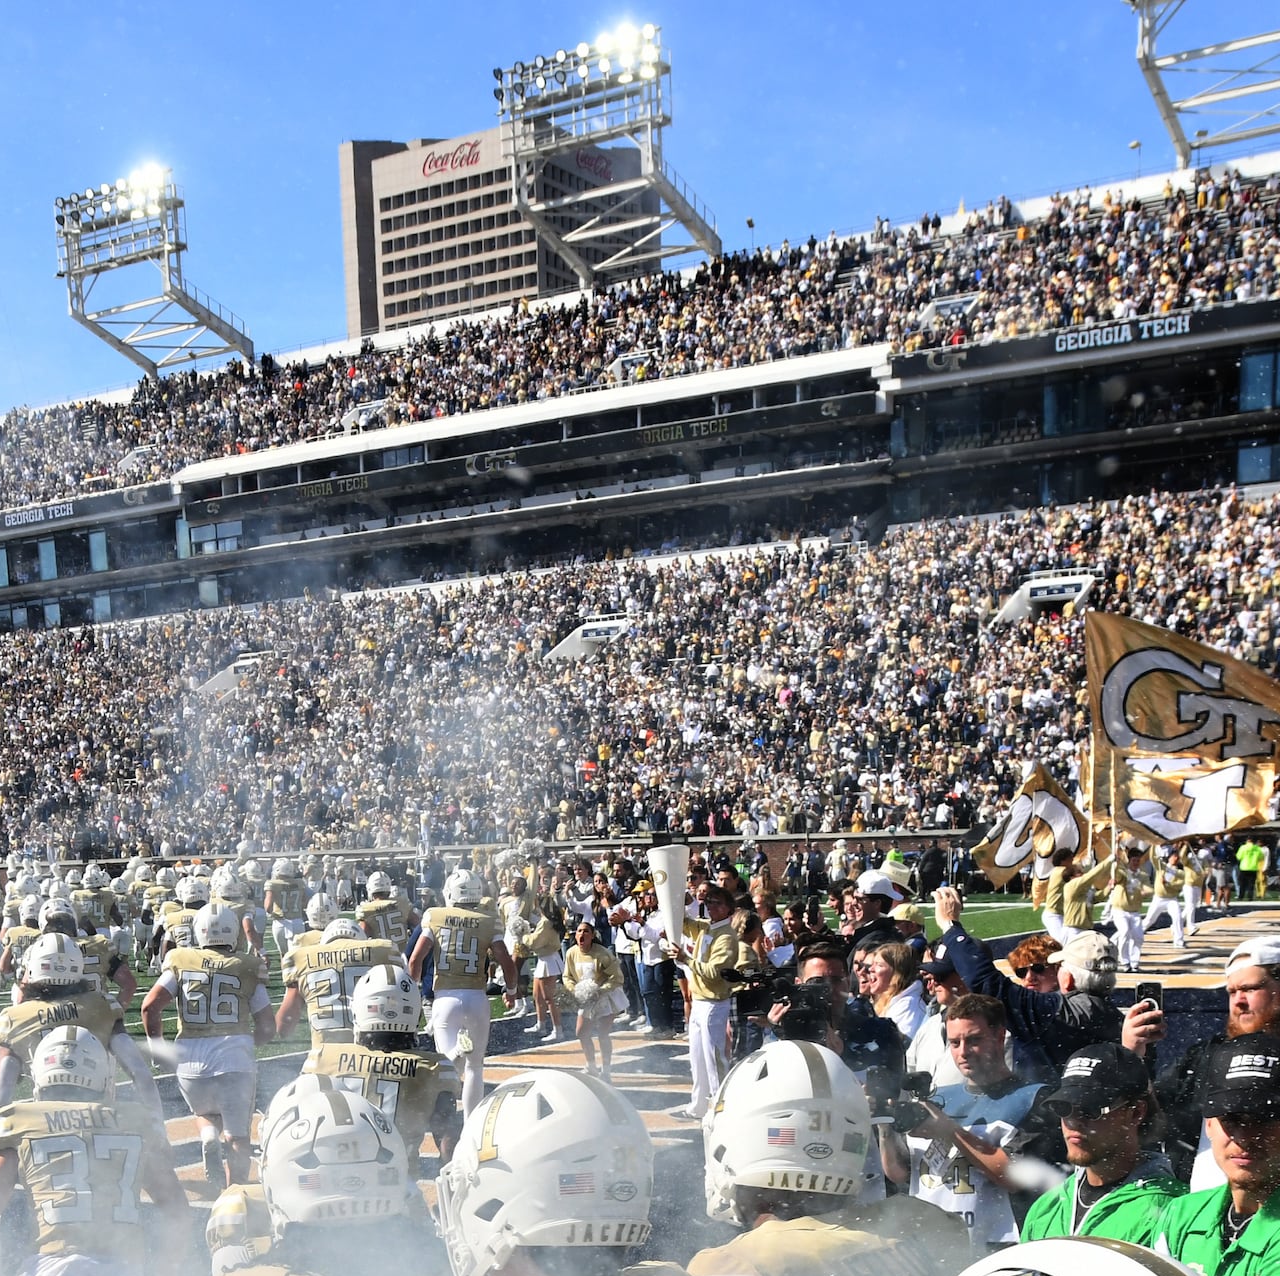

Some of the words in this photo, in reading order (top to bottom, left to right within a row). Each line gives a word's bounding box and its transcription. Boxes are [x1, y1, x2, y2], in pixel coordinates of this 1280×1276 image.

[422, 139, 484, 177] Coca-Cola
[1055, 321, 1133, 354] GEORGIA
[1138, 314, 1192, 342] TECH
[636, 426, 684, 446] ORGIA
[691, 418, 729, 438] TECH
[296, 481, 333, 498] ORGIA
[337, 476, 369, 494] TECH
[4, 506, 45, 528] GEORGIA
[47, 502, 74, 521] TECH
[376, 911, 407, 943] 15
[445, 916, 480, 929] KNOWLES
[306, 946, 372, 970] L.PRITCHETT
[437, 927, 479, 975] 14
[181, 970, 241, 1024] 66
[38, 1003, 79, 1025] CANION
[370, 1024, 410, 1032] JACKETS
[337, 1052, 419, 1079] PATTERSON
[1067, 1057, 1102, 1069] BEST
[1230, 1054, 1279, 1068] BEST
[47, 1073, 93, 1087] JACKETS
[44, 1108, 120, 1134] MOSELEY
[808, 1110, 831, 1132] 31
[337, 1142, 360, 1161] 21
[30, 1134, 143, 1225] 37
[768, 1172, 854, 1193] JACKETS
